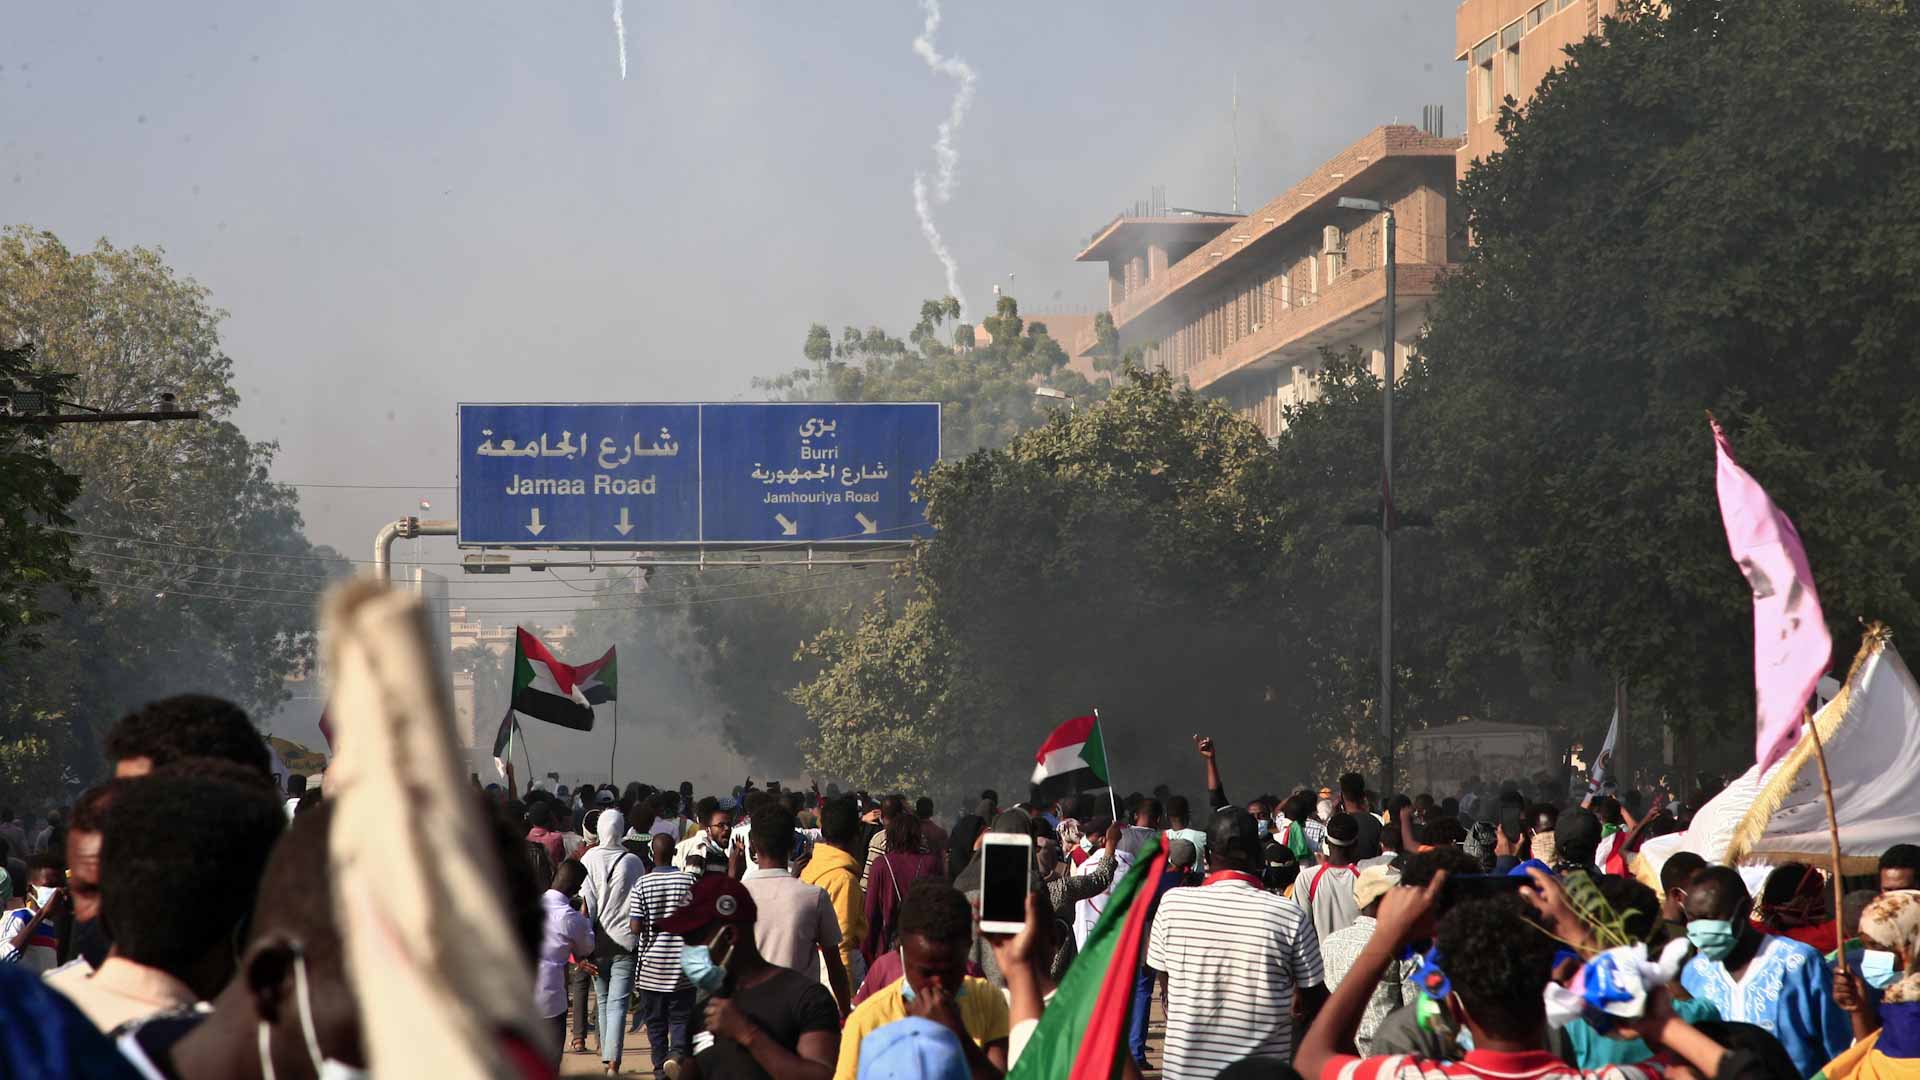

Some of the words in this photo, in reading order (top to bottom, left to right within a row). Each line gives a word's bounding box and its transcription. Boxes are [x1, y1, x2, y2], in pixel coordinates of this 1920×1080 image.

[476, 428, 588, 460] الجامعة
[598, 426, 679, 469] شارع
[801, 446, 838, 460] Burri
[505, 474, 585, 496] Jamaa
[594, 474, 656, 495] Road
[751, 462, 836, 485] الجمهورية
[840, 461, 888, 486] شارع
[763, 490, 841, 506] Jamhouriya
[845, 490, 880, 503] Road
